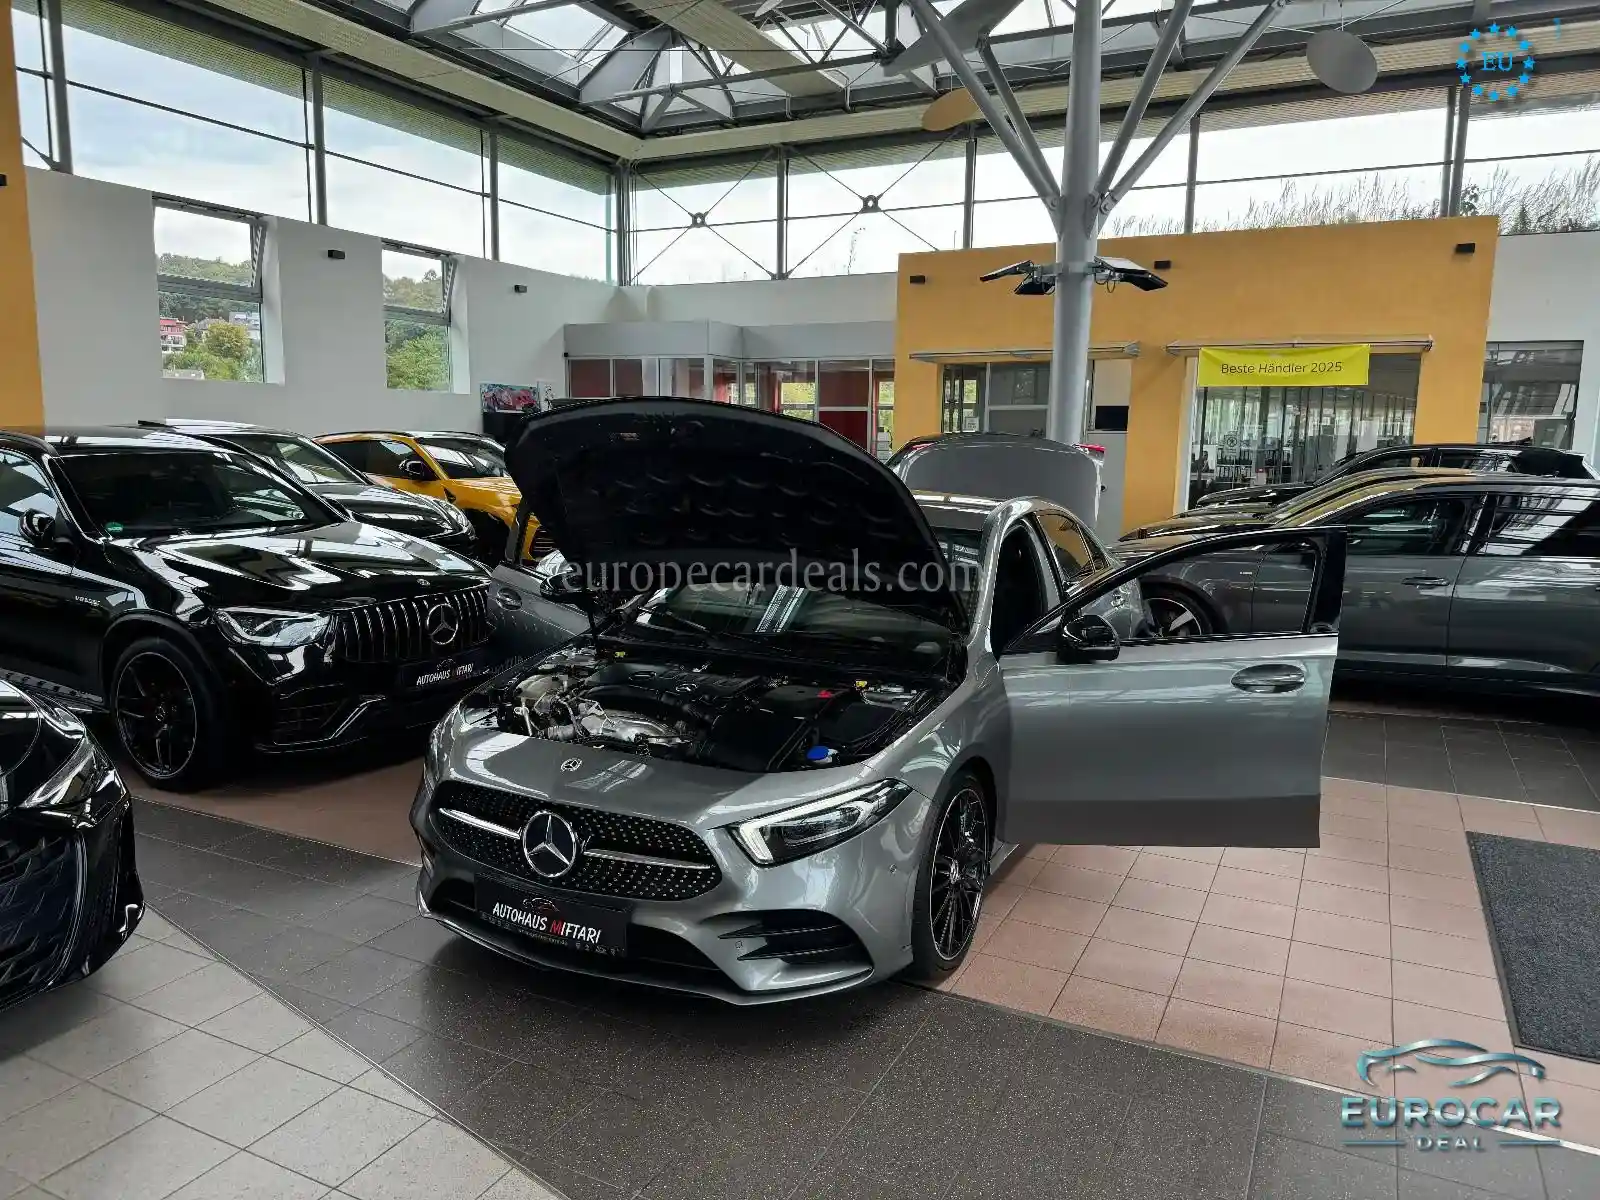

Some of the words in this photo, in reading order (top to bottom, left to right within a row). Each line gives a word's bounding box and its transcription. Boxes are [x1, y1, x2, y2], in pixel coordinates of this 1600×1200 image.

[1221, 363, 1255, 374] Beste
[1258, 362, 1308, 374] Händler
[1311, 361, 1343, 373] 2025
[416, 669, 451, 686] AUTOHAUS
[493, 901, 548, 931] AUTOHAUS
[551, 919, 602, 944] MIFTARI
